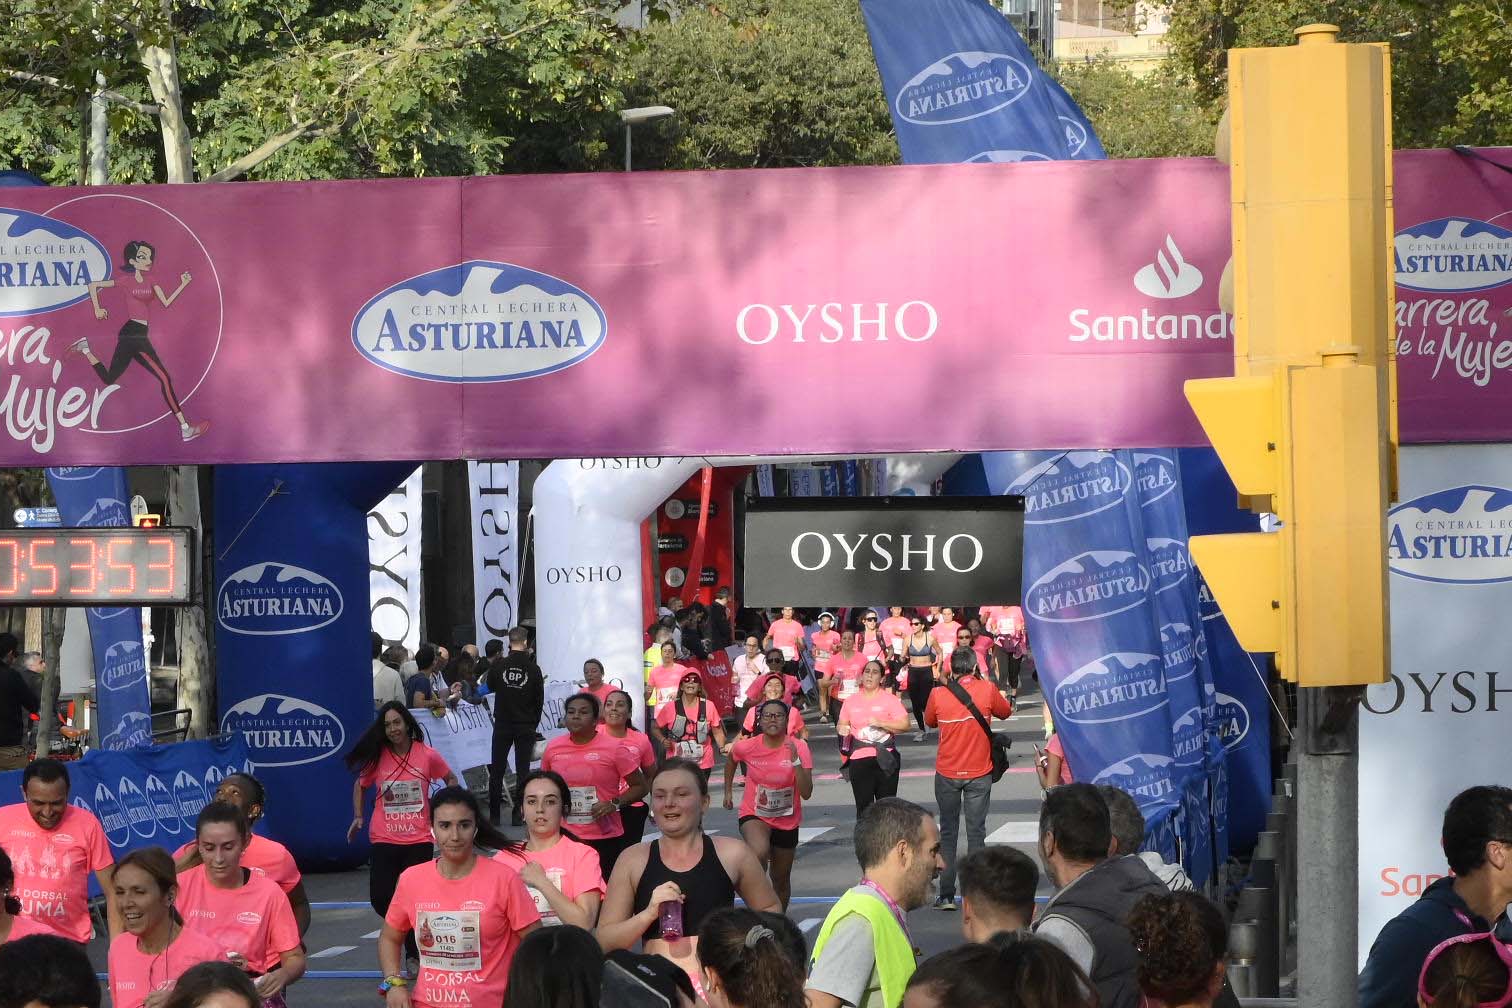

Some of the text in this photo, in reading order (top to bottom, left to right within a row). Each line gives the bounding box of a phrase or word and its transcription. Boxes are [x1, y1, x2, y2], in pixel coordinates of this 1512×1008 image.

[15, 245, 86, 255] LECHERA
[1409, 243, 1460, 251] CENTRAL
[411, 301, 578, 317] CENTRAL LECHERA
[736, 301, 938, 345] OYSHO
[371, 309, 588, 353] ASTURIANA
[1418, 329, 1436, 355] la
[1416, 521, 1475, 530] CENTRAL
[791, 532, 984, 573] OYSHO
[546, 565, 622, 585] OYSHO
[234, 587, 329, 595] CENTRAL LECHERA
[221, 592, 334, 619] ASTURIANA
[236, 719, 330, 727] CENTRAL LECHERA
[386, 823, 416, 832] SUMA
[23, 889, 68, 900] DORSAL
[21, 900, 65, 917] UMA
[436, 935, 456, 944] 016
[424, 972, 485, 986] DORSAL
[426, 988, 471, 1002] SUMA
